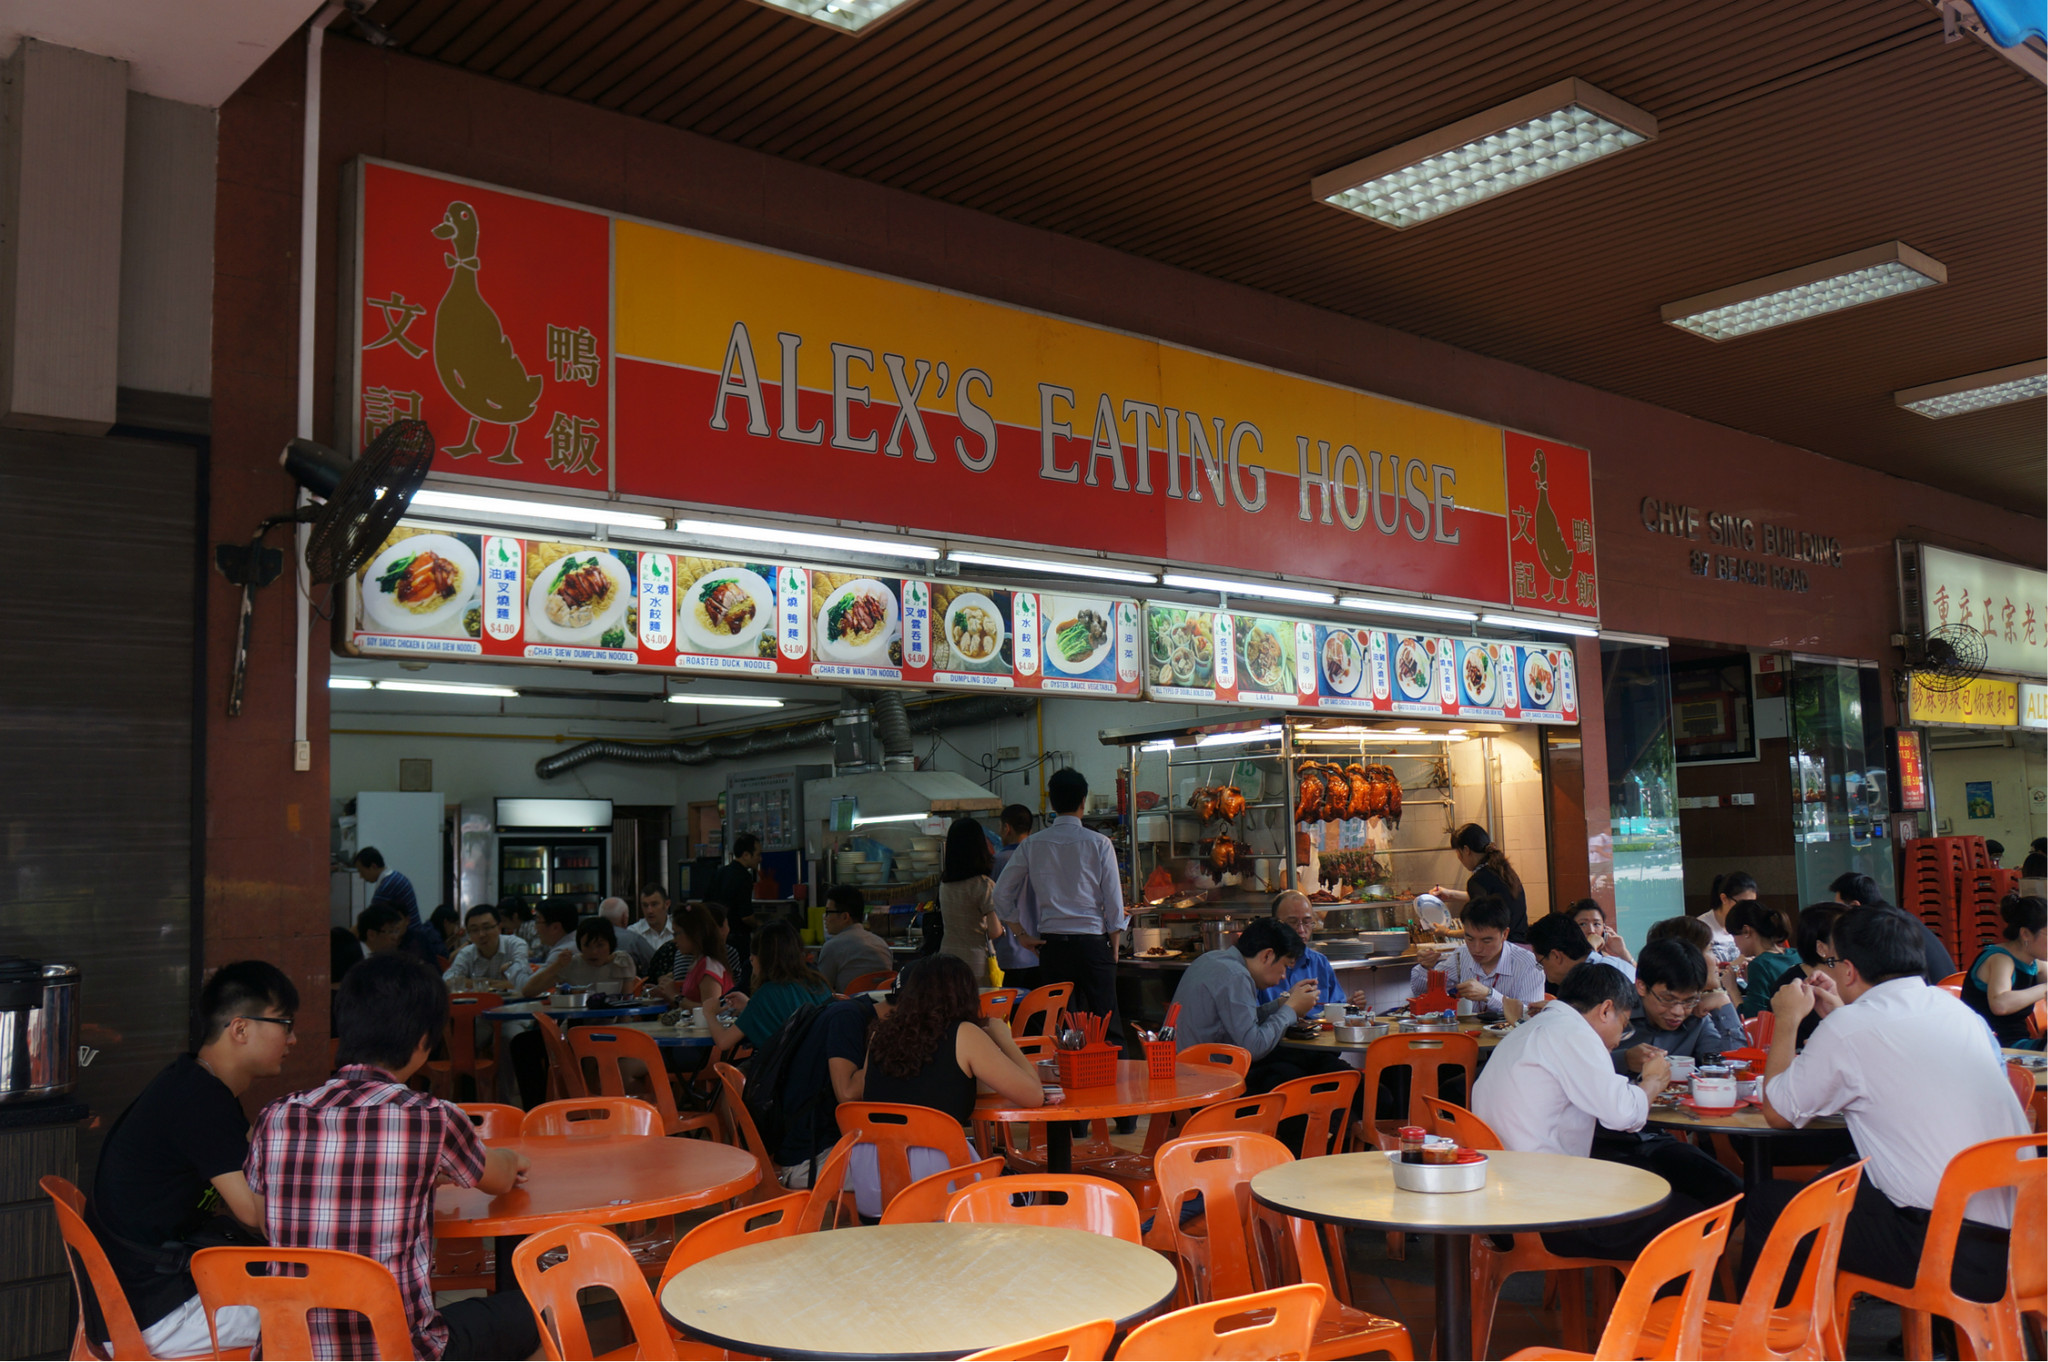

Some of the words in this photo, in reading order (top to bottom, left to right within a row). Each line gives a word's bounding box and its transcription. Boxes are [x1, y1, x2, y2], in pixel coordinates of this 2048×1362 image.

[544, 323, 602, 476] 鴨飯
[709, 321, 998, 473] ALEX'S
[1037, 382, 1267, 513] EATING
[1295, 436, 1461, 545] HOUSE
[1640, 496, 1700, 541] CHYE
[1708, 511, 1754, 552] SING
[1762, 523, 1843, 569] BUILDING
[1512, 505, 1537, 599] 文記
[1572, 518, 1596, 608] 鴨飯
[1714, 553, 1767, 587] BEACH
[1770, 564, 1809, 593] ROAD
[1933, 584, 2047, 648] 重庆正宗老
[490, 623, 515, 634] $4.00
[366, 637, 377, 646] SOY
[380, 638, 396, 648] SAUCE
[398, 639, 419, 649] CHICKEN
[421, 641, 425, 649] &
[427, 641, 441, 650] CHAR
[442, 642, 455, 651] SIEW
[456, 643, 477, 653] NOODLE
[645, 633, 667, 644] $4.00
[534, 647, 552, 656] CHAR
[555, 648, 571, 657] SIEW
[574, 649, 607, 659] DUMPLING
[609, 652, 633, 661] NOODLE
[784, 644, 803, 654] $4.00
[686, 656, 719, 666] ROASTED
[722, 659, 741, 667] DUCK
[744, 660, 771, 669] NOODLE
[908, 653, 926, 663] $4.00
[837, 666, 851, 675] SIEW
[853, 667, 866, 675] WAN
[867, 668, 878, 676] TON
[879, 669, 899, 678] NOODLE
[1018, 662, 1035, 671] $4.00
[950, 674, 980, 684] DUMPLING
[982, 677, 998, 685] SOUP
[1071, 682, 1086, 690] SAUCE
[1088, 683, 1114, 691] VEGETABLE
